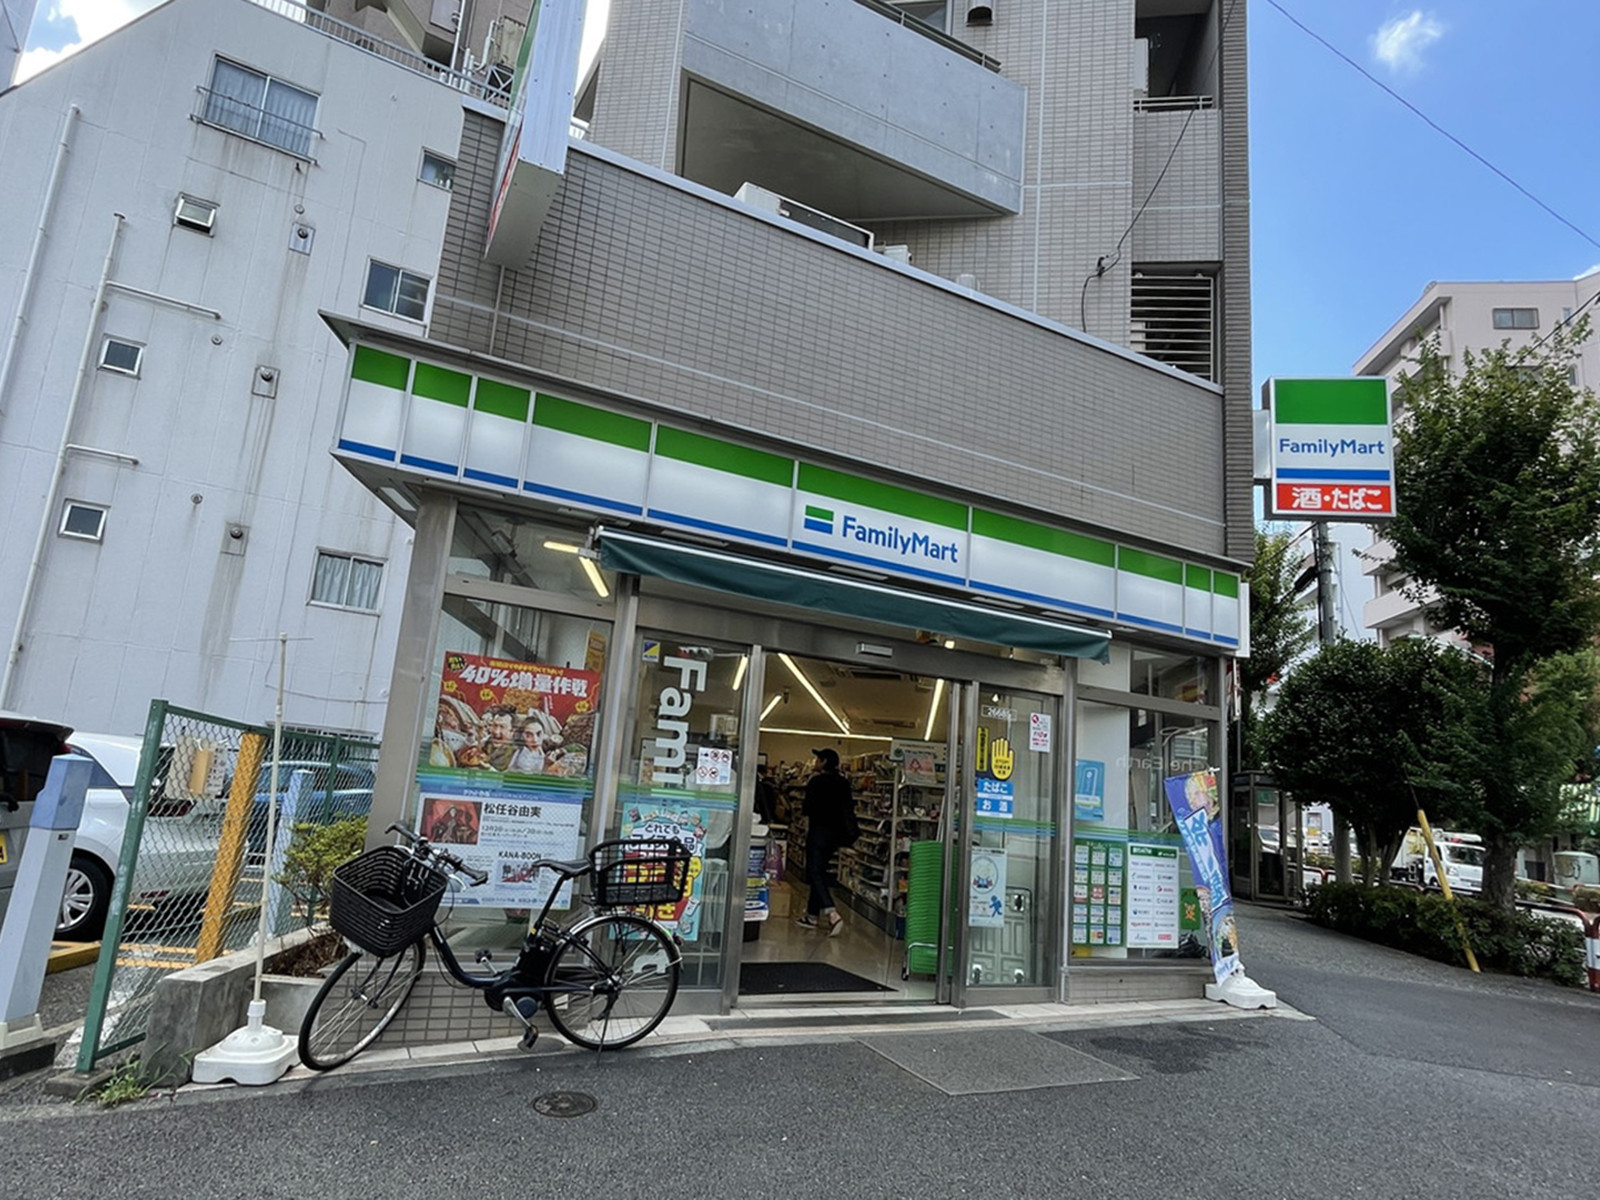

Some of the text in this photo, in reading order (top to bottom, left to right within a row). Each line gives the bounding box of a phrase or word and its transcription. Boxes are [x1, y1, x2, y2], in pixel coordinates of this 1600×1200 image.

[1279, 438, 1385, 458] FamilyMart
[1291, 486, 1383, 510] 酒・たばこ
[841, 514, 958, 563] FamilyMart
[459, 664, 589, 697] 40%増量作戦
[982, 781, 1009, 794] たばこ
[484, 803, 542, 818] 松任谷由実
[498, 851, 542, 860] KANA-BOON
